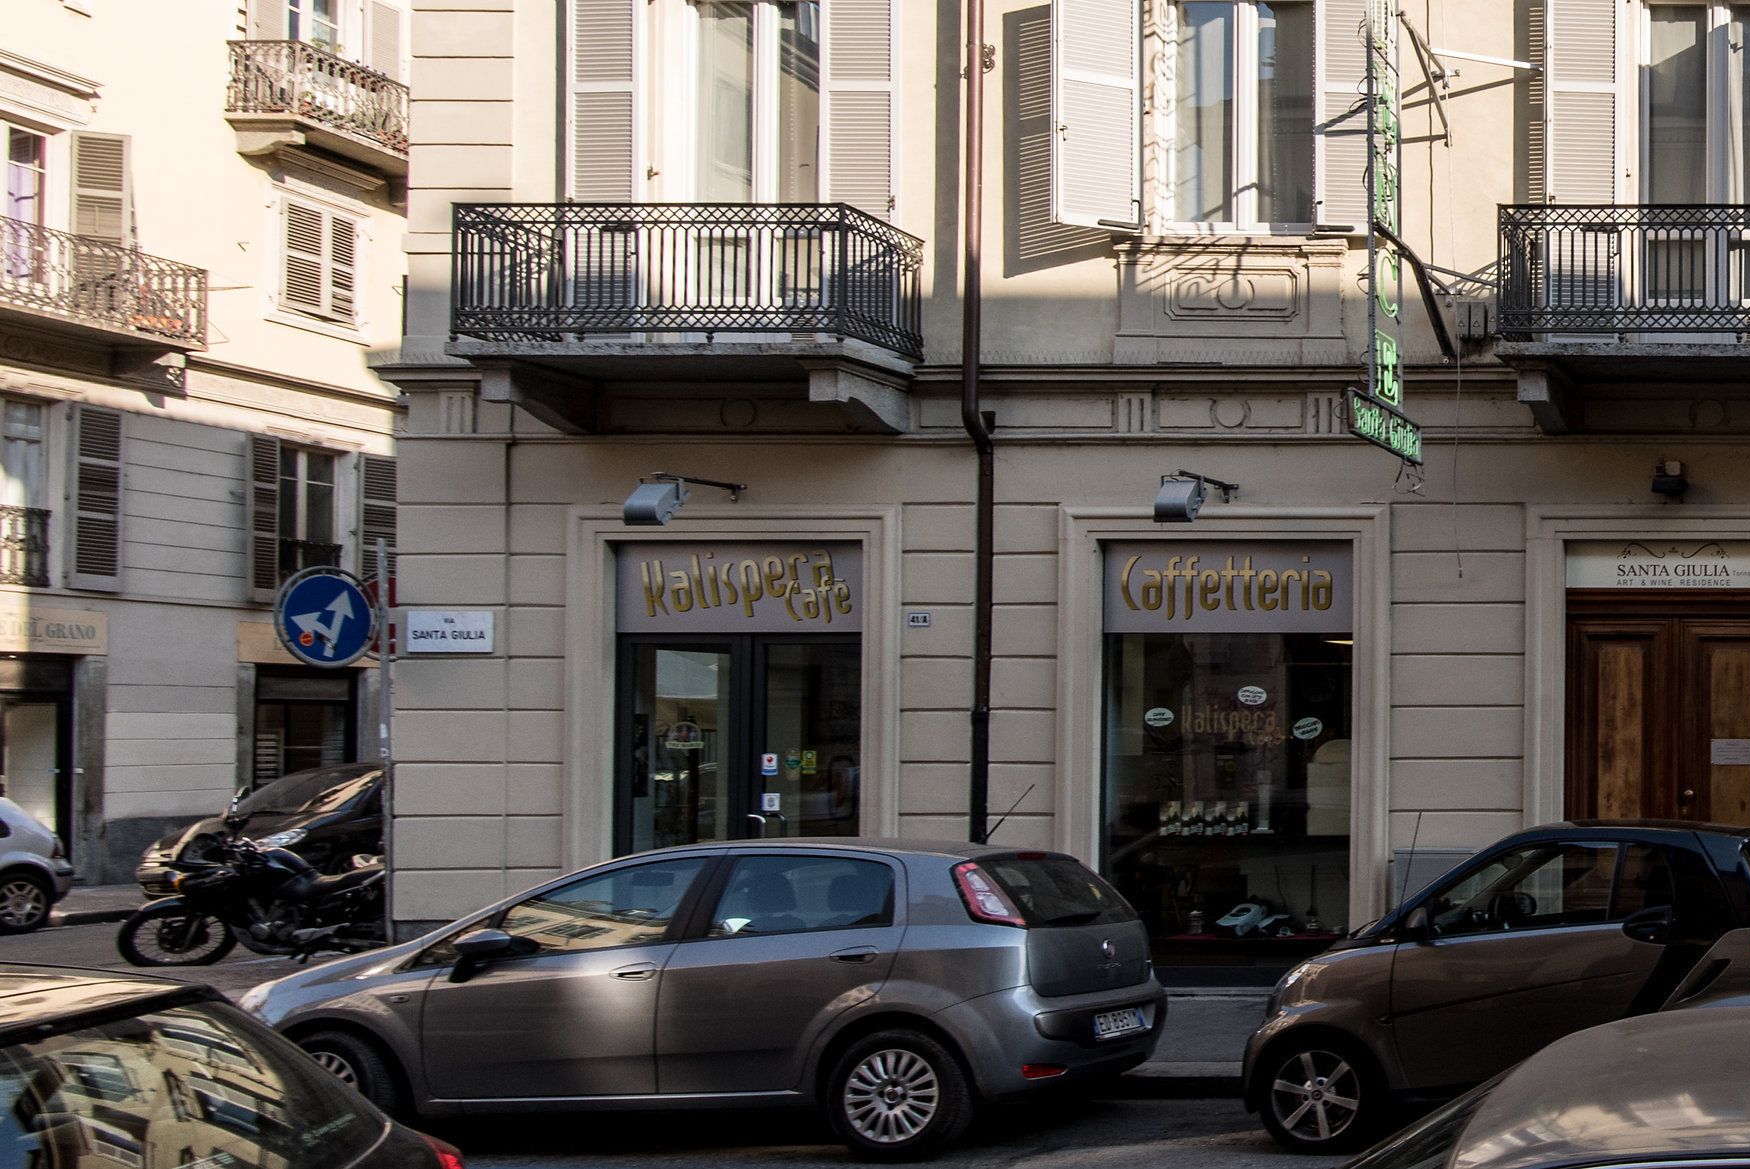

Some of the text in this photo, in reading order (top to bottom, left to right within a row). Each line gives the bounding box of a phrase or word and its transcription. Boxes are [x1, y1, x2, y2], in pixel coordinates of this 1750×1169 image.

[641, 549, 834, 617] Kalispera
[1121, 555, 1333, 620] Caffetteria
[1617, 564, 1670, 577] SANTA
[1674, 564, 1730, 577] GIULIA
[412, 630, 486, 640] SANTA GIULIA
